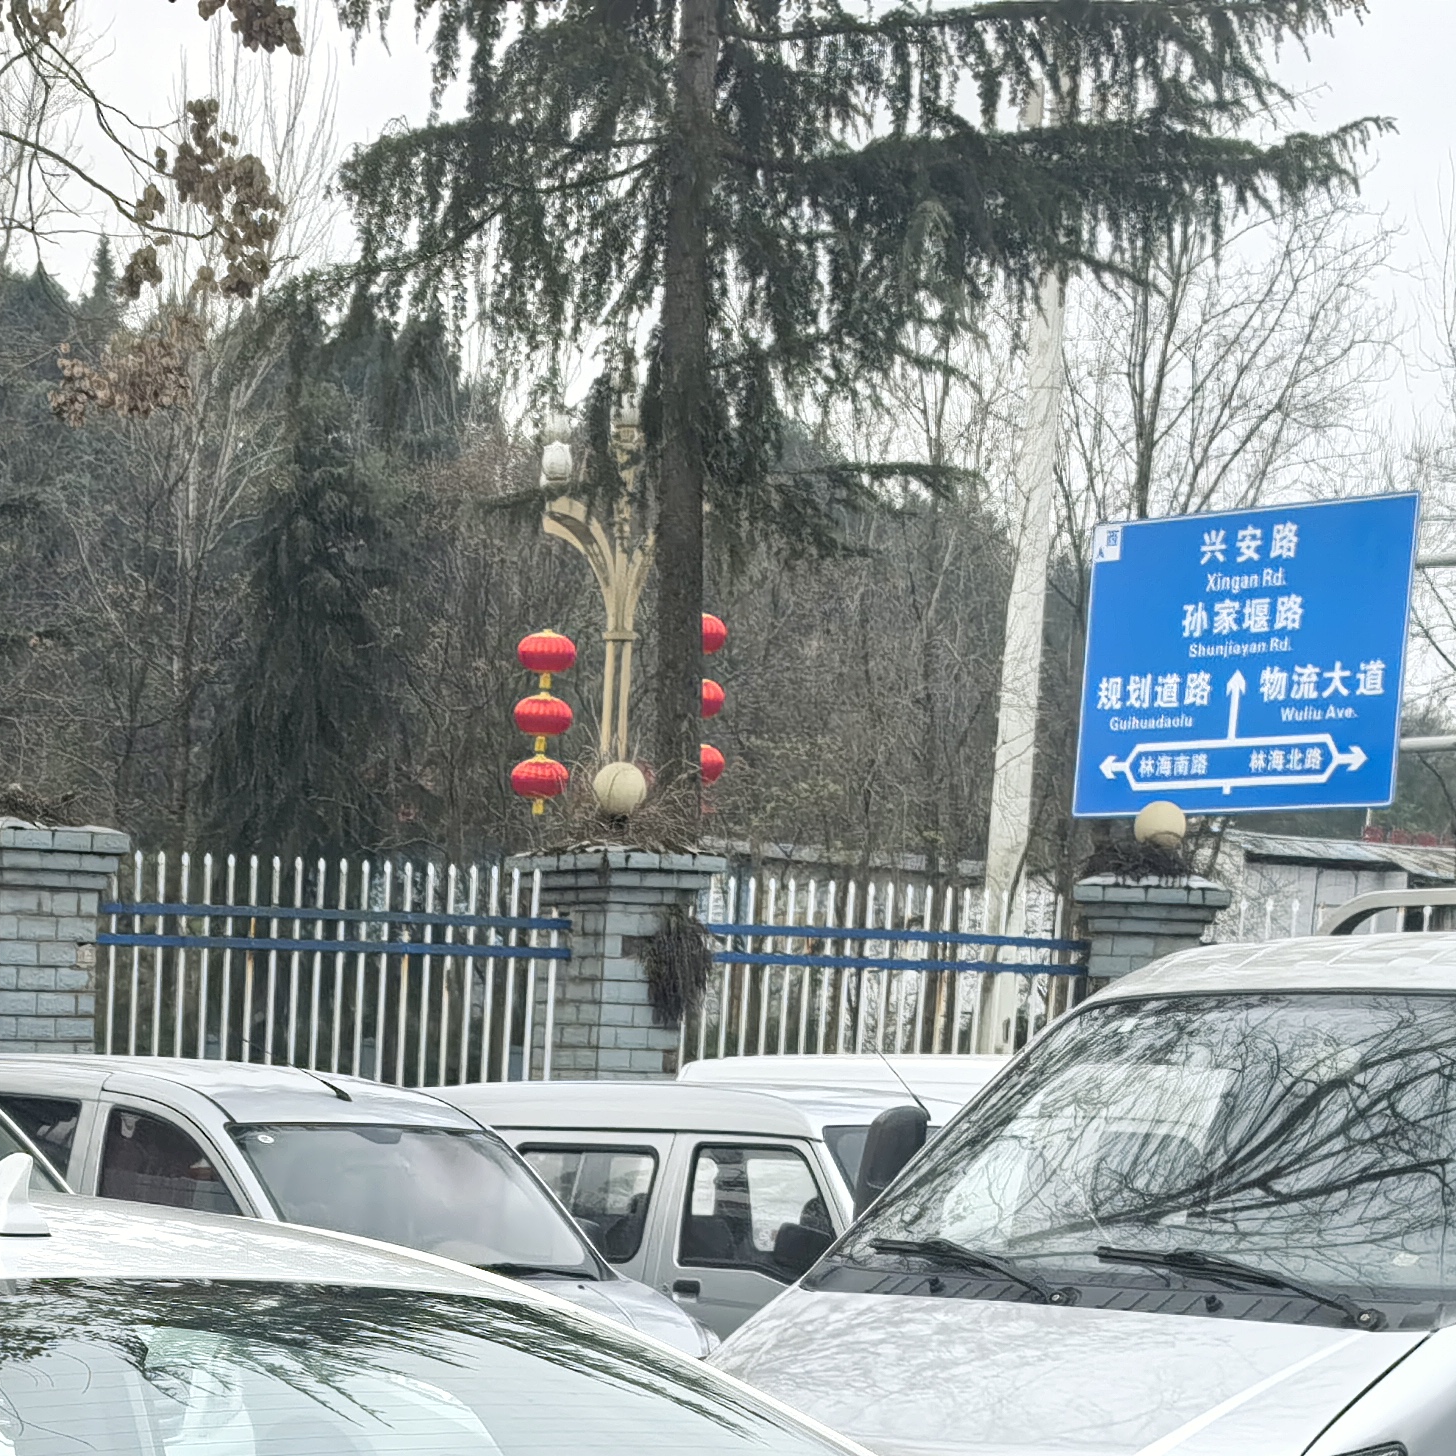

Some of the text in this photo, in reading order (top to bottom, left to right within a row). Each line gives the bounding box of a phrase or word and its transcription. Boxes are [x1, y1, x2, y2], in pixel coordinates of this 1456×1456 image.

[1200, 520, 1299, 565] 兴安路
[1205, 566, 1287, 594] Xingan Rd.
[1181, 593, 1304, 638] 孙家堰路
[1269, 635, 1294, 652] Rd.
[1096, 669, 1212, 710] 规划道路
[1259, 658, 1386, 702] 物流大道
[1280, 704, 1323, 722] Wuliu
[1138, 752, 1209, 778] 林海南路
[1248, 746, 1324, 774] 林海北路
